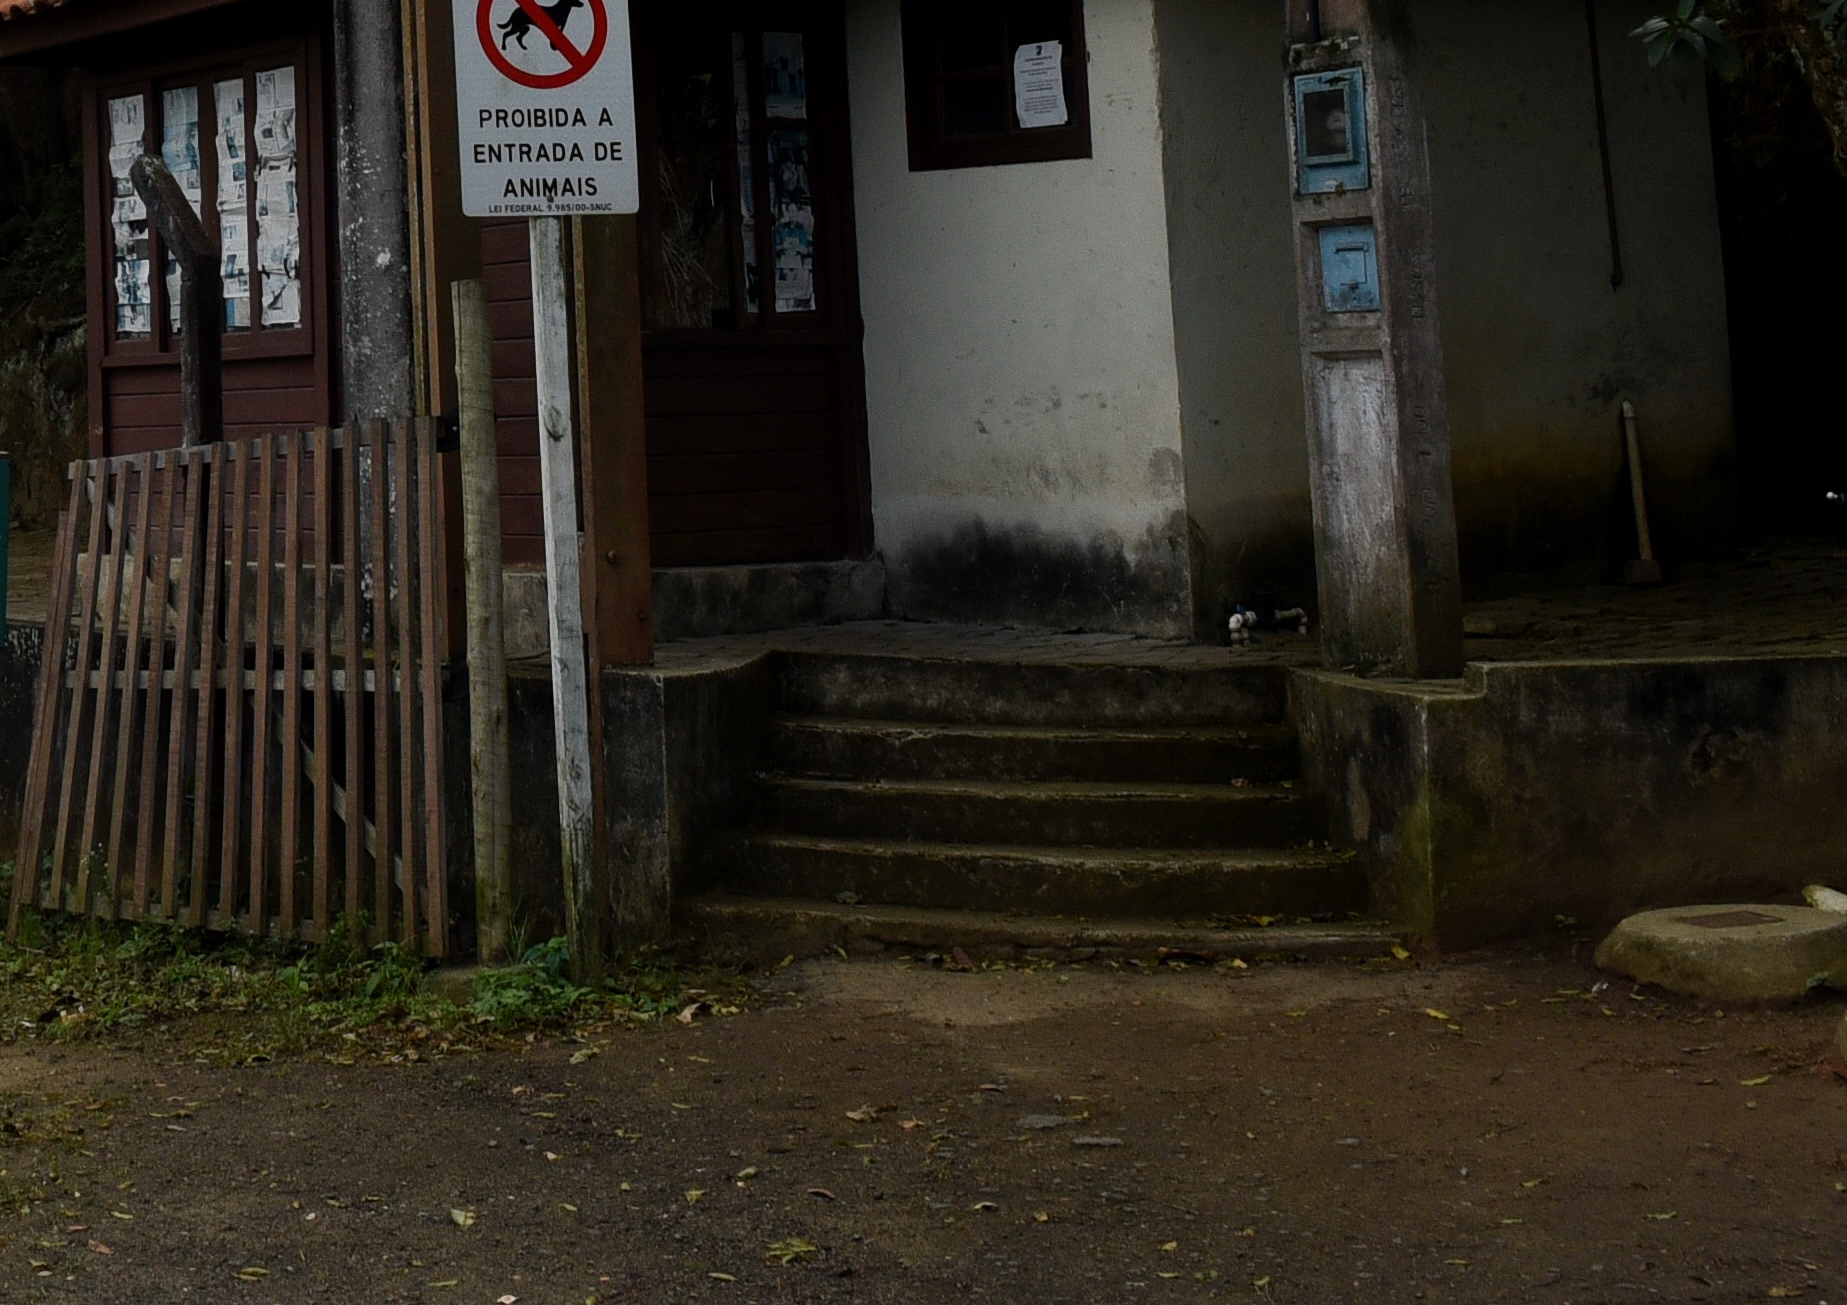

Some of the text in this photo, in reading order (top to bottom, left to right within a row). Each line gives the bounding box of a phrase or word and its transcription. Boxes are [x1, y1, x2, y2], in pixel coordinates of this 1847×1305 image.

[479, 108, 613, 128] PROIBIDA A
[474, 142, 622, 163] ENTRADA DE
[504, 178, 597, 197] ANIMAIS
[489, 205, 502, 214] LEI
[505, 204, 543, 213] FEDERAL
